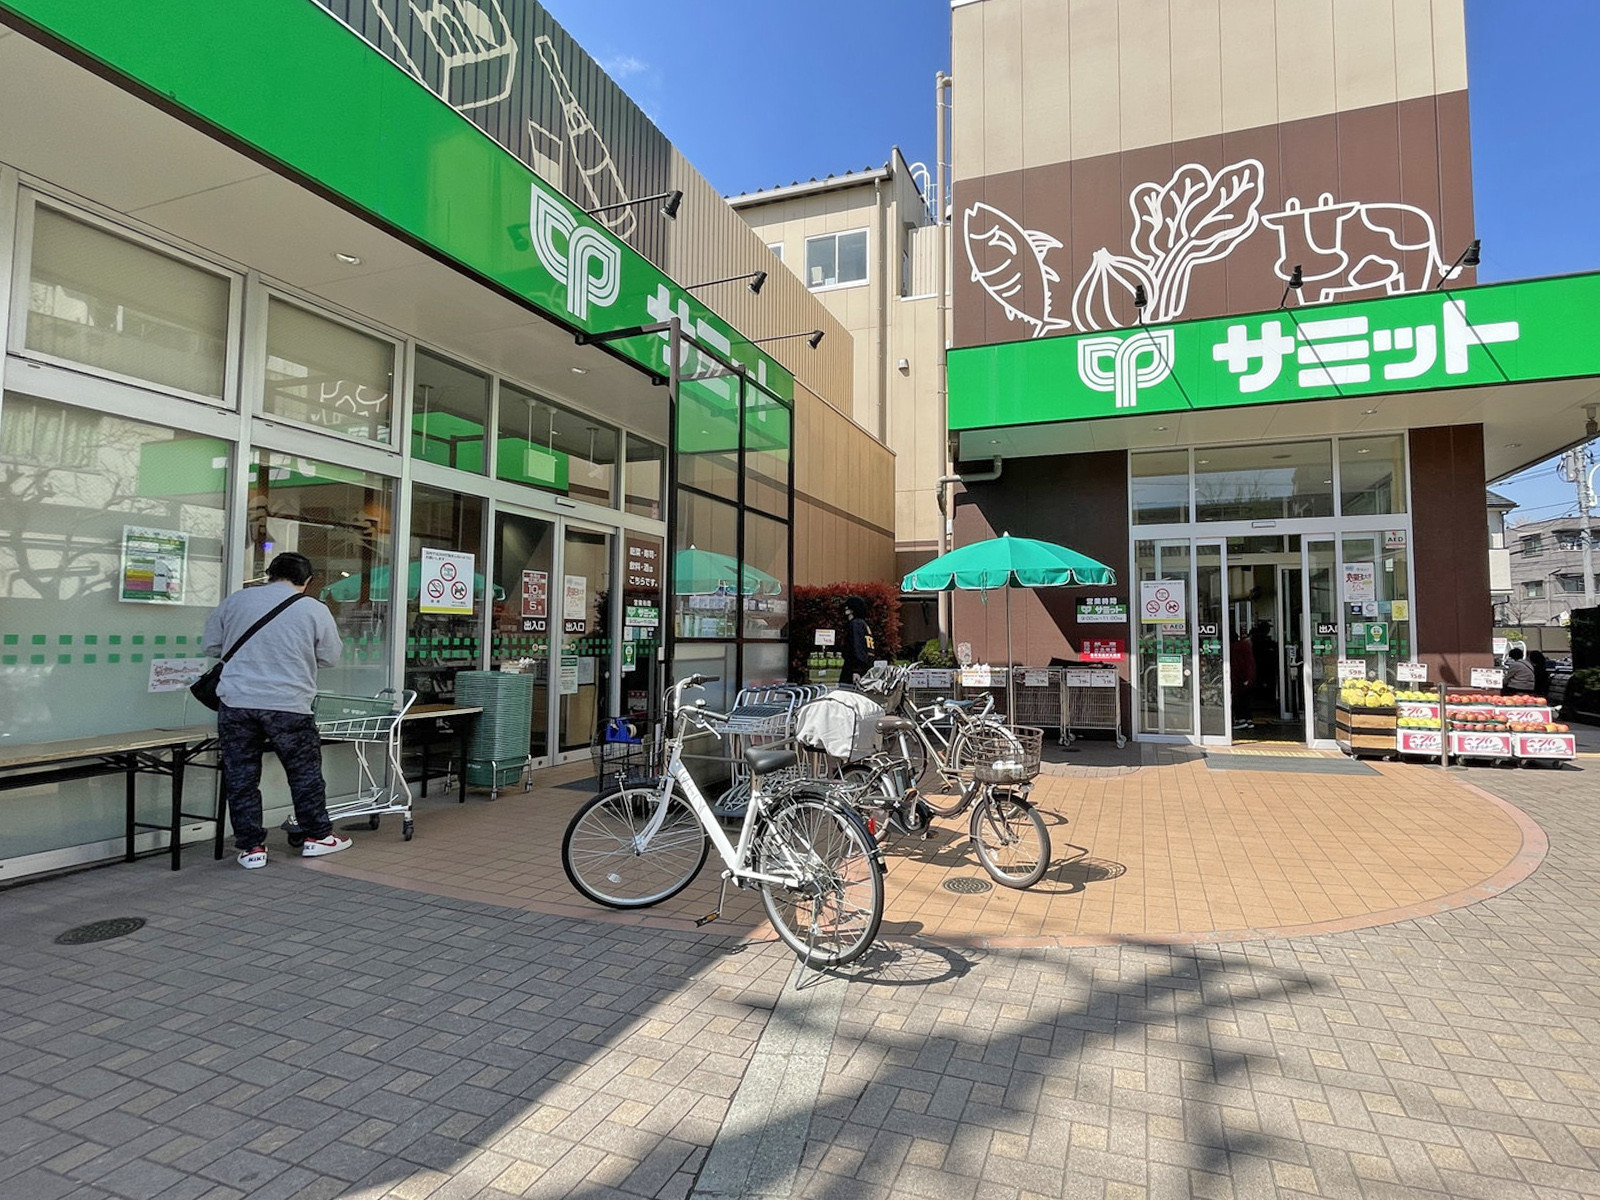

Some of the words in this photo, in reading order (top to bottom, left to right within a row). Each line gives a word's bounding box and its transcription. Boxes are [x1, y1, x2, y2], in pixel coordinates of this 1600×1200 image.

[1213, 300, 1520, 394] サミット
[629, 576, 658, 587] こちらです。
[1094, 605, 1123, 614] サミット
[523, 620, 546, 631] 出入口
[565, 621, 585, 632] 出入口
[1199, 625, 1216, 634] 入口
